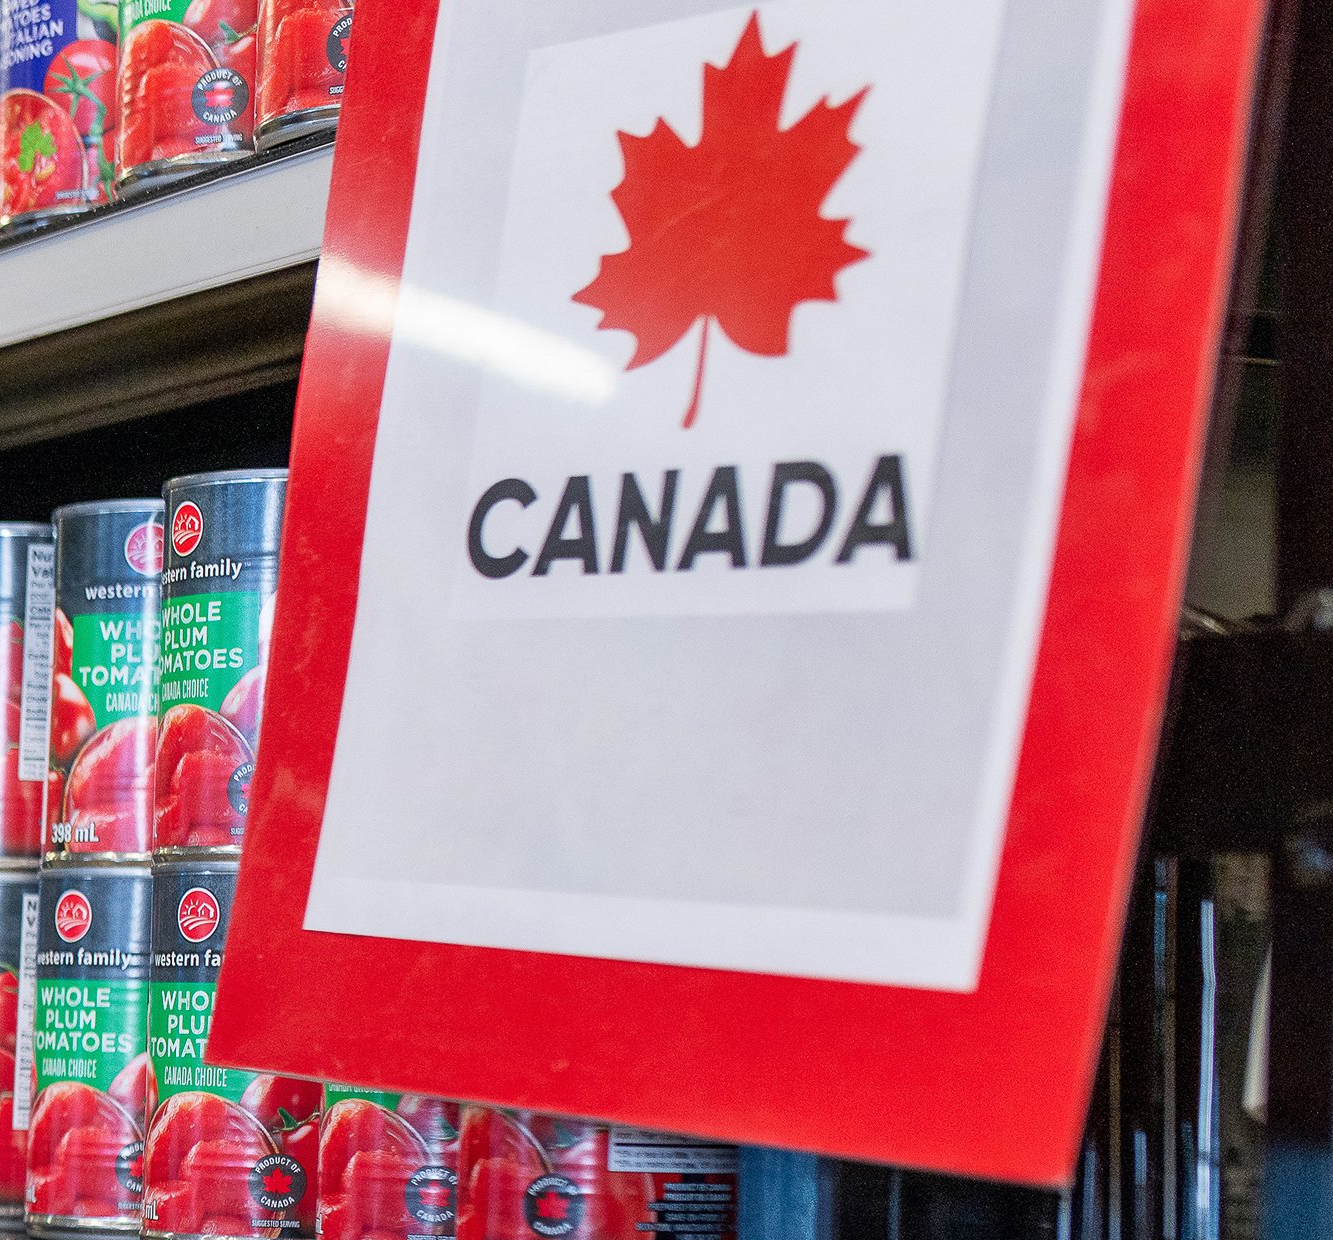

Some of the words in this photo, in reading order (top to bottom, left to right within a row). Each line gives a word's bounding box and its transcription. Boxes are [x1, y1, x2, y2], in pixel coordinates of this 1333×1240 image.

[333, 17, 353, 37] PROD
[198, 73, 232, 92] PRODUCT
[232, 75, 243, 88] OF
[203, 109, 238, 124] CANADA
[467, 452, 915, 580] CANADA
[189, 557, 243, 583] family
[85, 582, 154, 601] western
[162, 601, 222, 627] WHOLE
[100, 620, 161, 642] WHO
[165, 626, 208, 651] PLUM
[111, 643, 160, 664] PLU
[162, 682, 181, 702] CANADA
[182, 678, 209, 699] CHOICE
[51, 823, 72, 844] 398
[74, 821, 100, 844] mL
[77, 947, 132, 971] family
[154, 952, 200, 968] western
[41, 986, 111, 1009] WHOLE
[45, 1009, 97, 1030] PLUM
[68, 1058, 98, 1079] CHOICE
[164, 1066, 193, 1086] CANADA
[194, 1067, 228, 1088] CHOICE
[255, 1157, 290, 1174] PRODUCT
[289, 1163, 301, 1174] OF
[145, 1199, 159, 1221] mL
[260, 1196, 295, 1208] CANADA
[251, 1219, 279, 1228] SUGGESTED
[416, 1209, 454, 1223] CANADA
